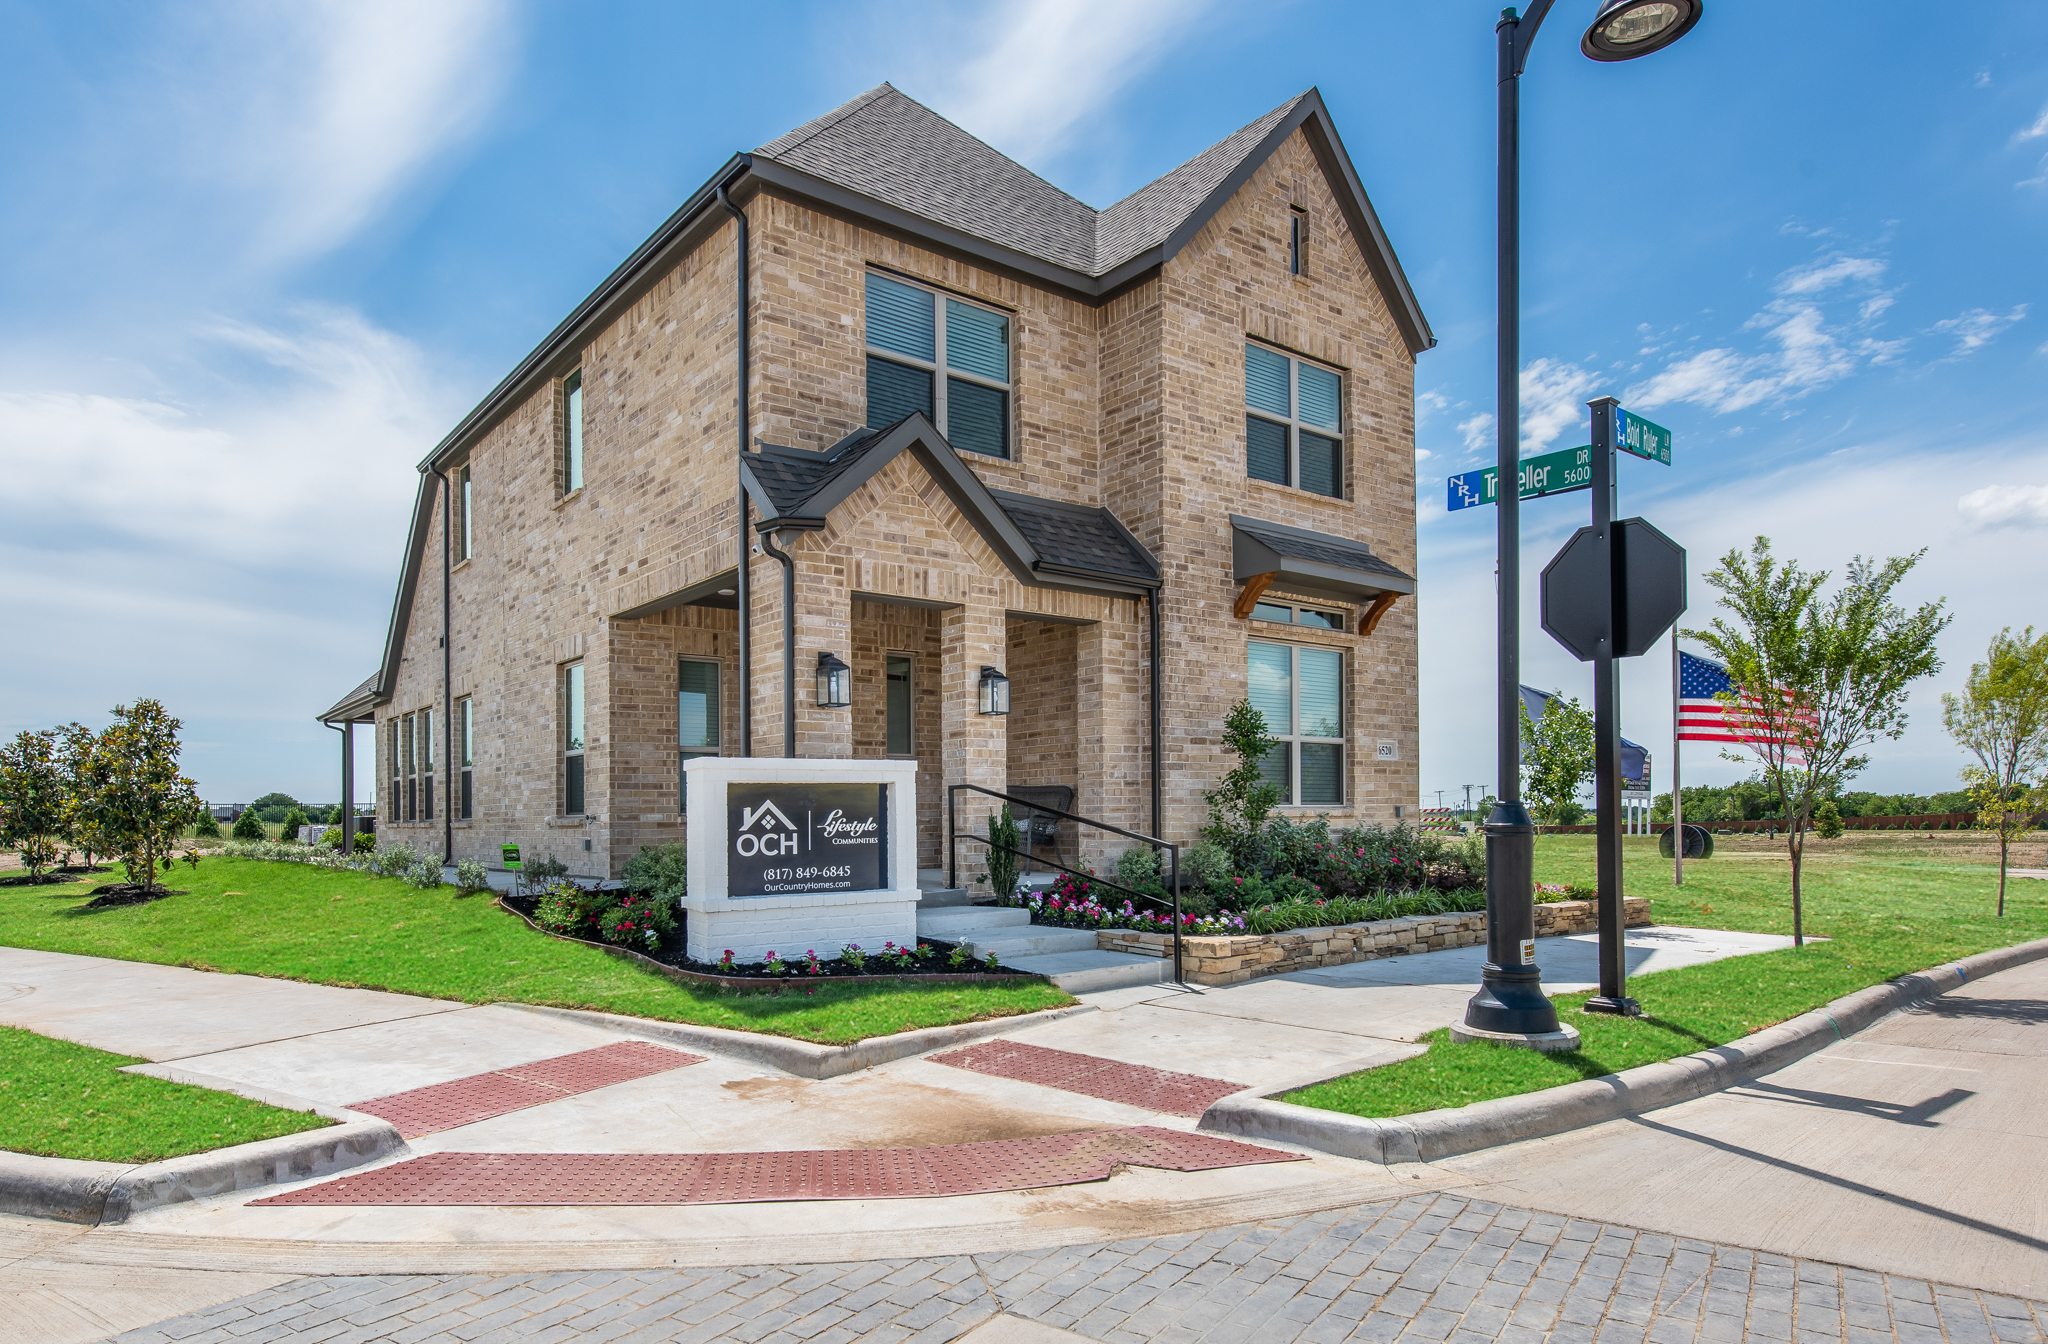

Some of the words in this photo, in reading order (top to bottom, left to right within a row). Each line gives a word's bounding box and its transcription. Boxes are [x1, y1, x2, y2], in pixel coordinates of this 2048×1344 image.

[1627, 417, 1640, 448] Bold
[1643, 425, 1658, 455] Ruler
[1577, 449, 1589, 465] DR
[1484, 465, 1551, 498] Treller
[1564, 466, 1590, 484] 5600
[817, 809, 878, 837] Lifestyle
[736, 833, 798, 857] OCH
[832, 837, 879, 845] COMMUNITIES
[763, 868, 793, 881] (817)
[795, 865, 851, 879] 849-6845
[764, 881, 851, 892] OurCountryHomes.com
